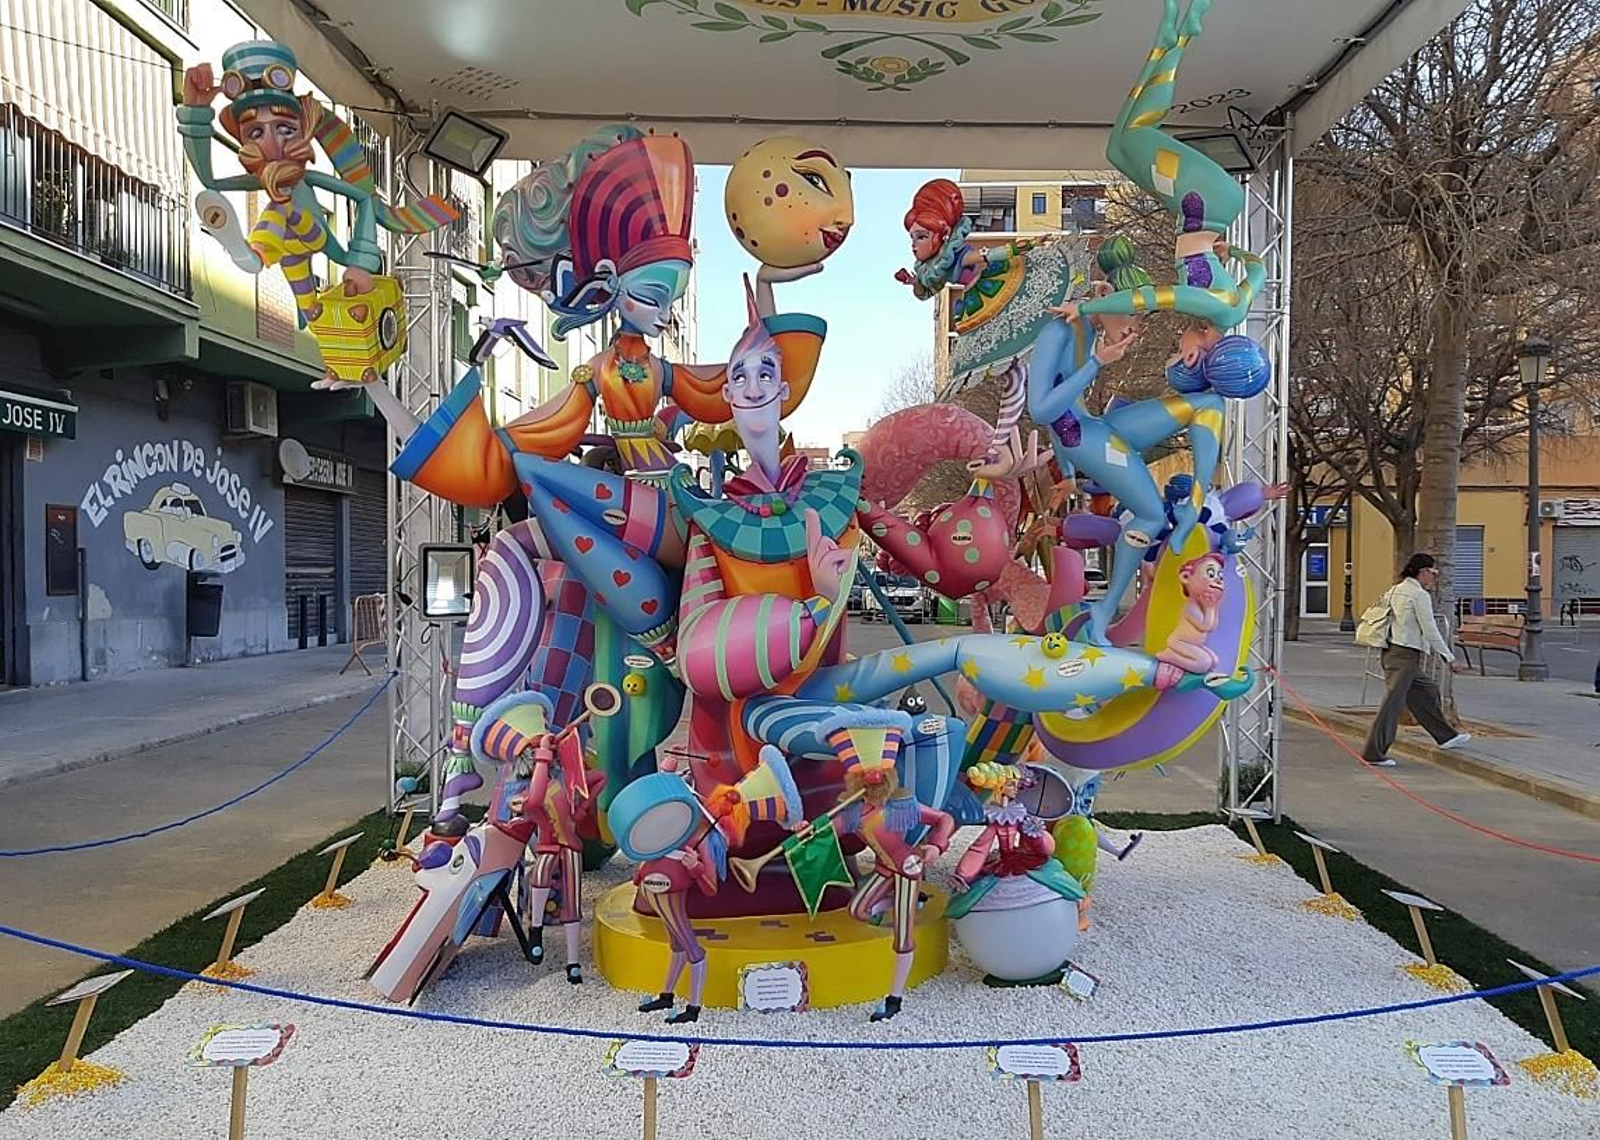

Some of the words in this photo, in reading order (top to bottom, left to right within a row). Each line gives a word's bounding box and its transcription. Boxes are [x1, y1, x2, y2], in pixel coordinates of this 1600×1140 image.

[1170, 88, 1251, 114] 2023
[2, 402, 43, 431] JOSE
[49, 411, 66, 434] IV
[248, 504, 275, 545] IV
